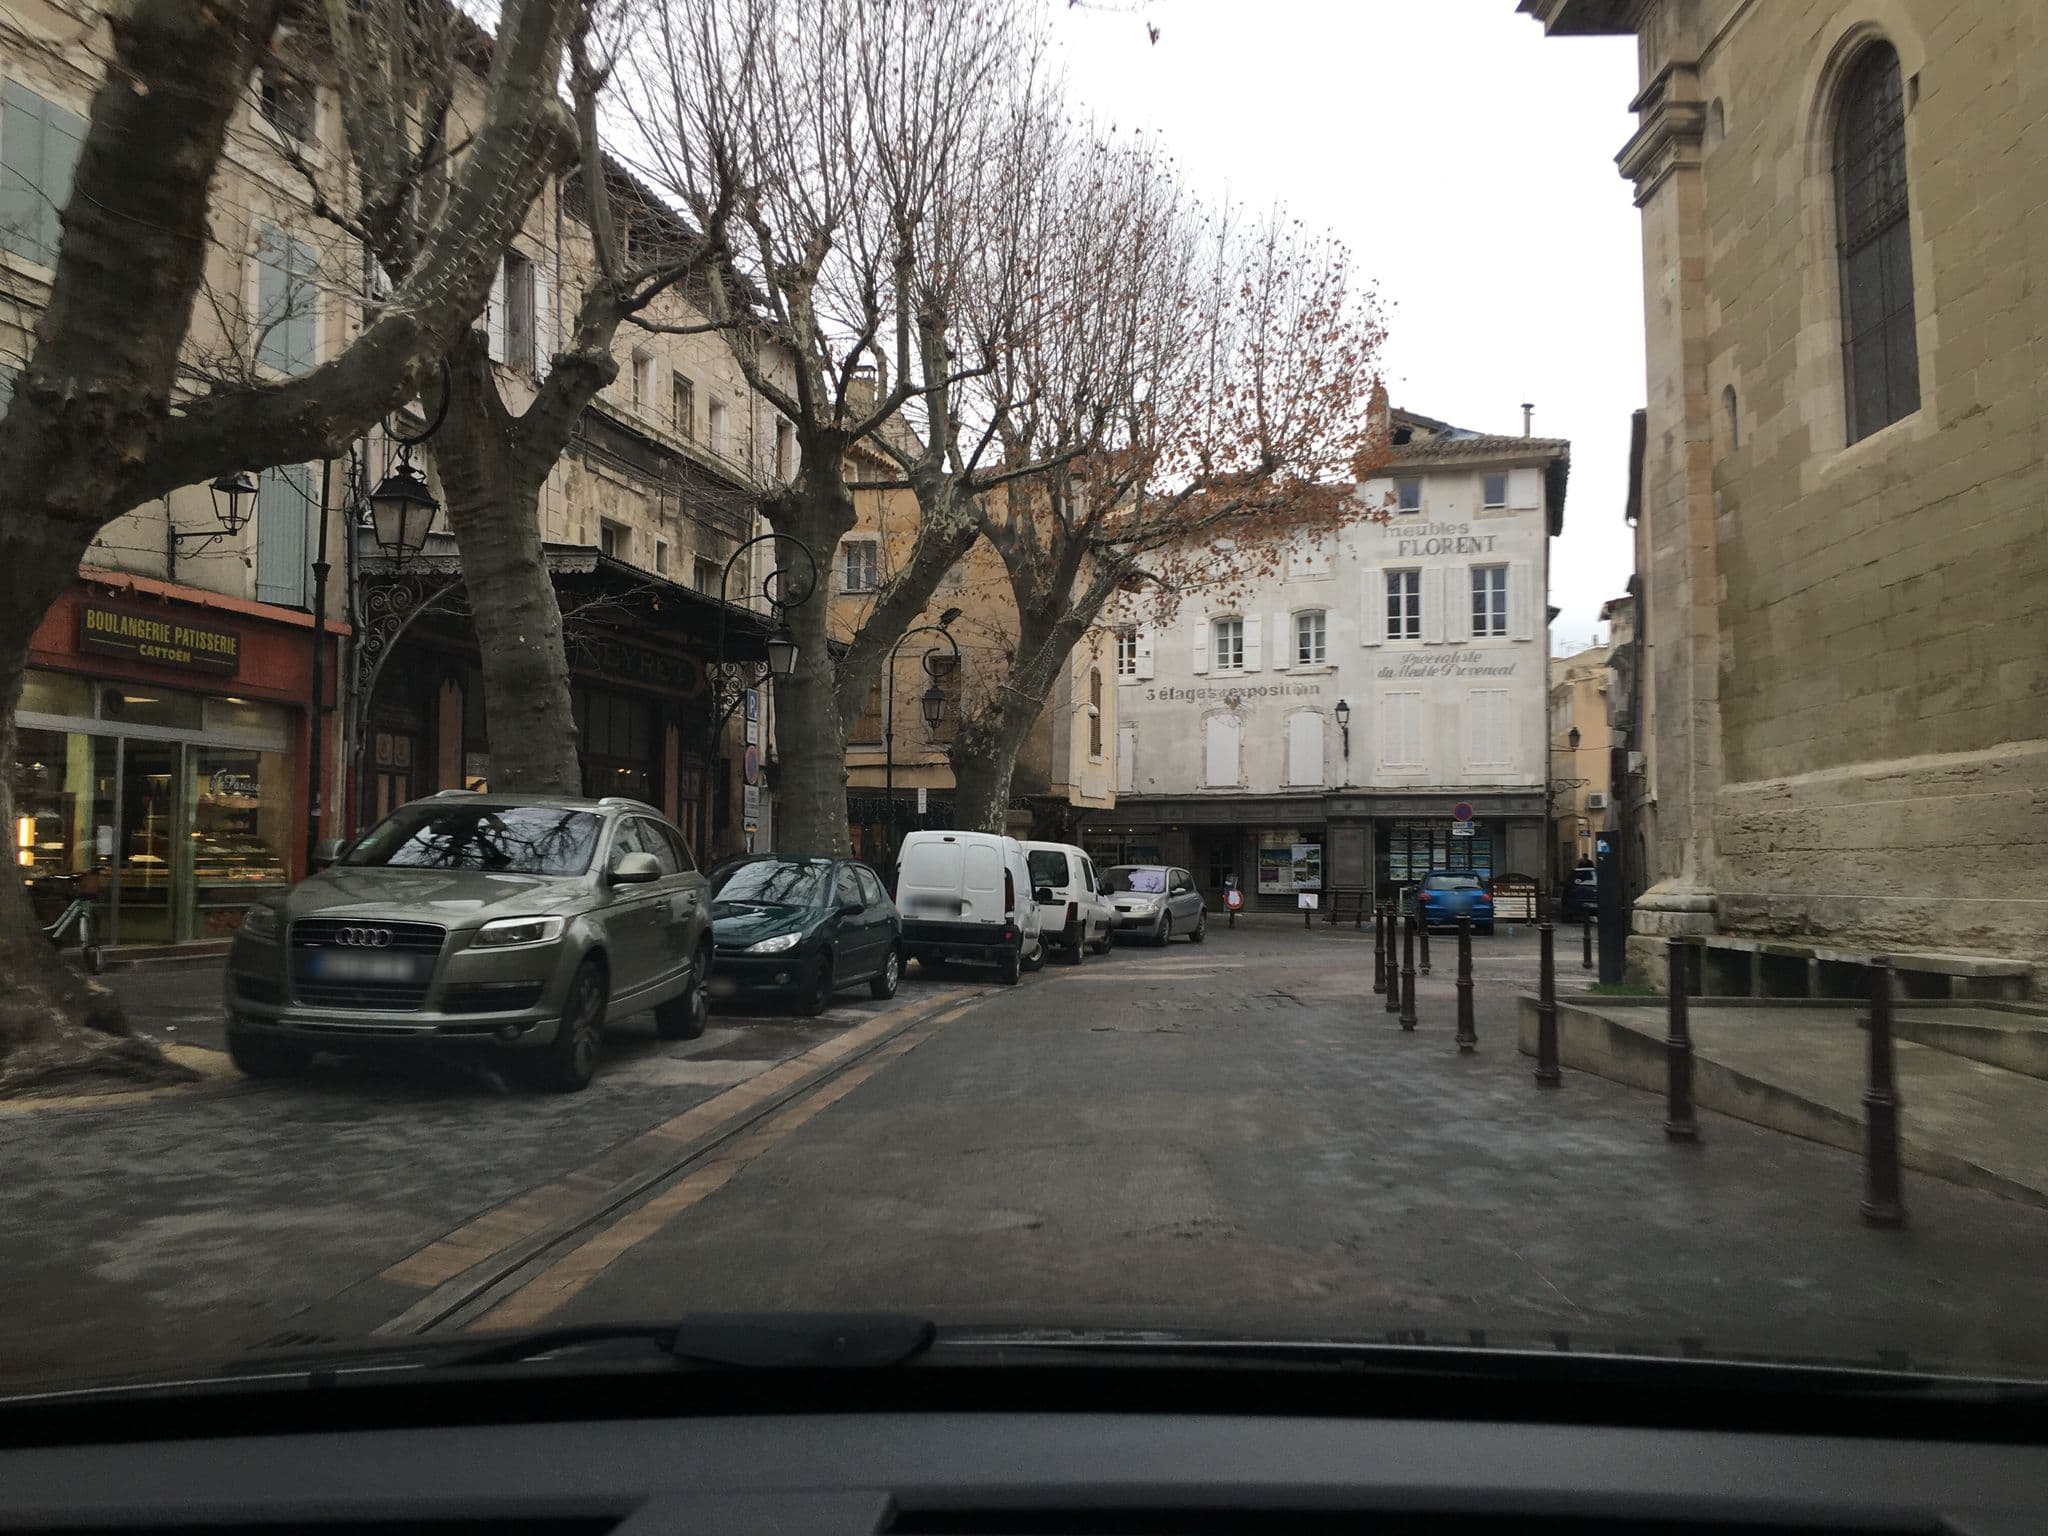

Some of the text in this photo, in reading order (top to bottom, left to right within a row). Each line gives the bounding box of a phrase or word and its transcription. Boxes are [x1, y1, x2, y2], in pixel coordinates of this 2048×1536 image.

[1382, 521, 1470, 538] meubles
[1398, 535, 1497, 557] FLORENT
[86, 609, 237, 656] BOULANGERIE PATISSERIE
[139, 643, 191, 663] CATTOEN
[1159, 686, 1217, 704] étages
